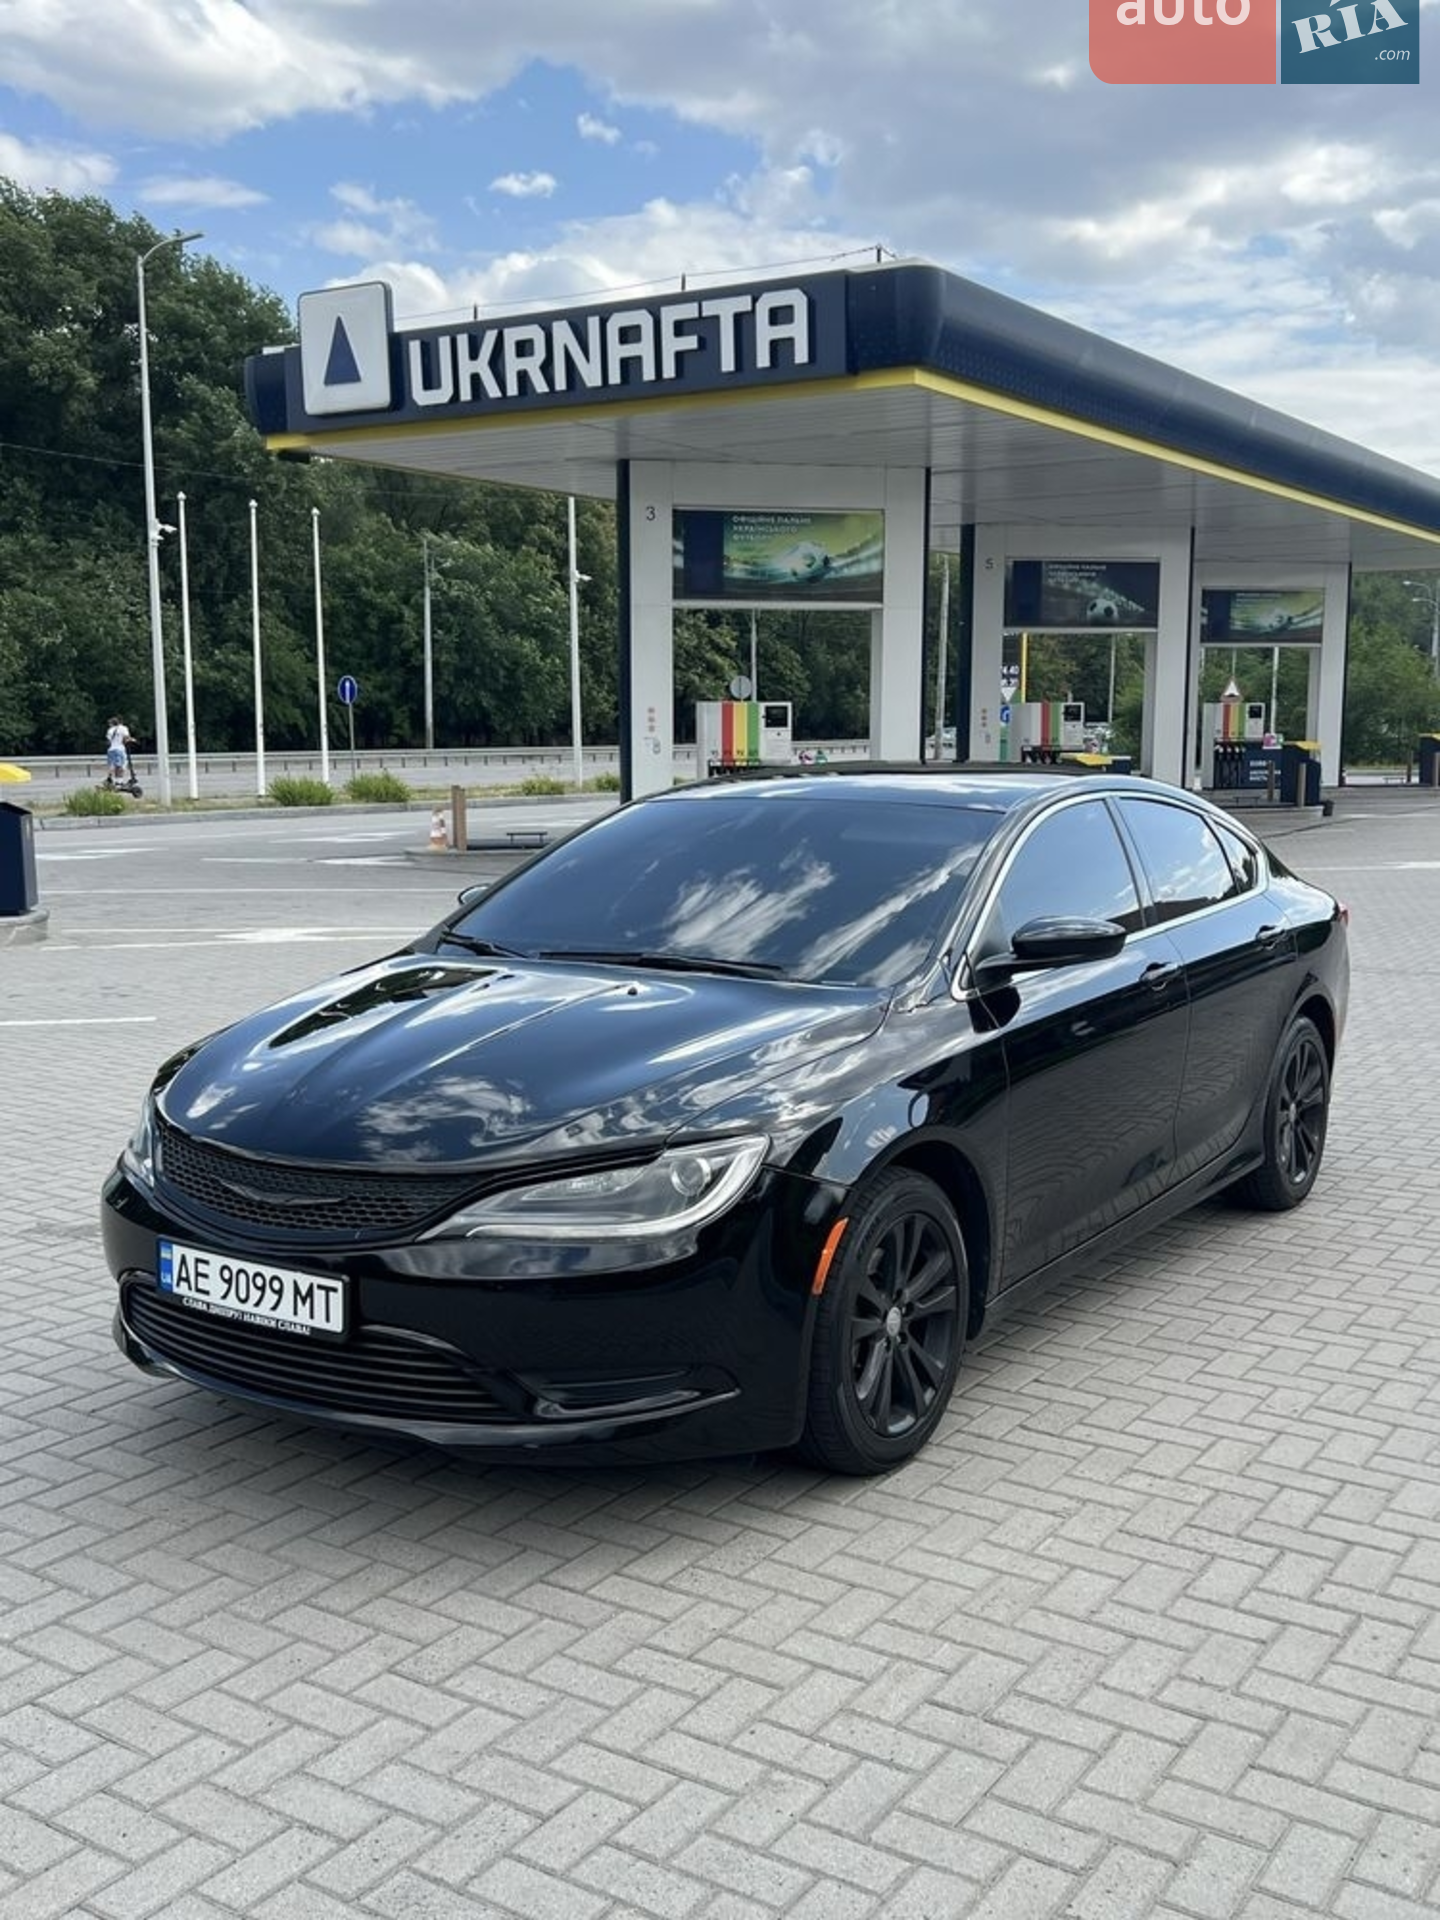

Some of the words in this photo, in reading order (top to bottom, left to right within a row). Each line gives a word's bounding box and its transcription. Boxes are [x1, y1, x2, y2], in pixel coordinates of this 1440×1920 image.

[408, 287, 809, 407] UKRNAFTA
[646, 506, 656, 521] 3
[176, 1253, 210, 1296] AE
[219, 1264, 285, 1311] 9099
[293, 1279, 338, 1323] MT
